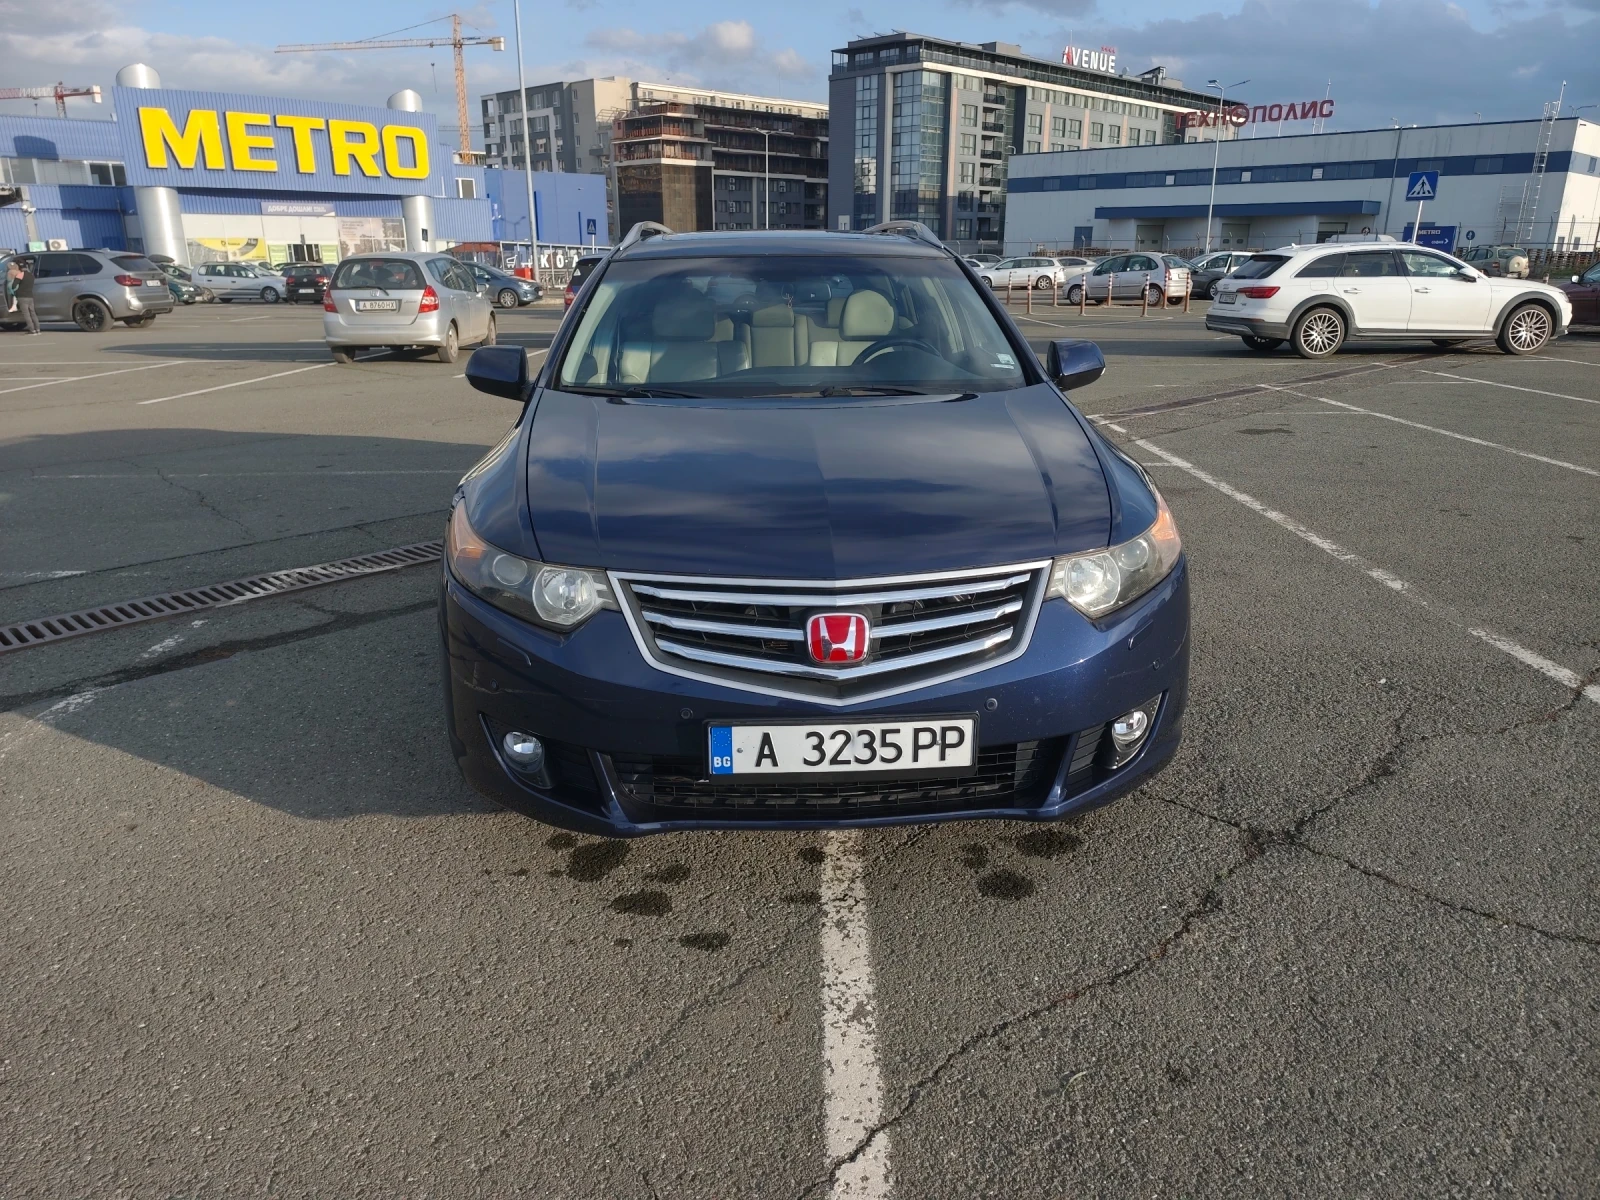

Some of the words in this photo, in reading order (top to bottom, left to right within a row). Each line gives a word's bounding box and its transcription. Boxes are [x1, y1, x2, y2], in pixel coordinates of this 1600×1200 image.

[1062, 45, 1116, 73] AVENUE
[1175, 99, 1335, 129] ТЕХНОПОЛИС
[138, 106, 430, 180] METRO
[713, 756, 731, 768] BG
[755, 732, 779, 767] A
